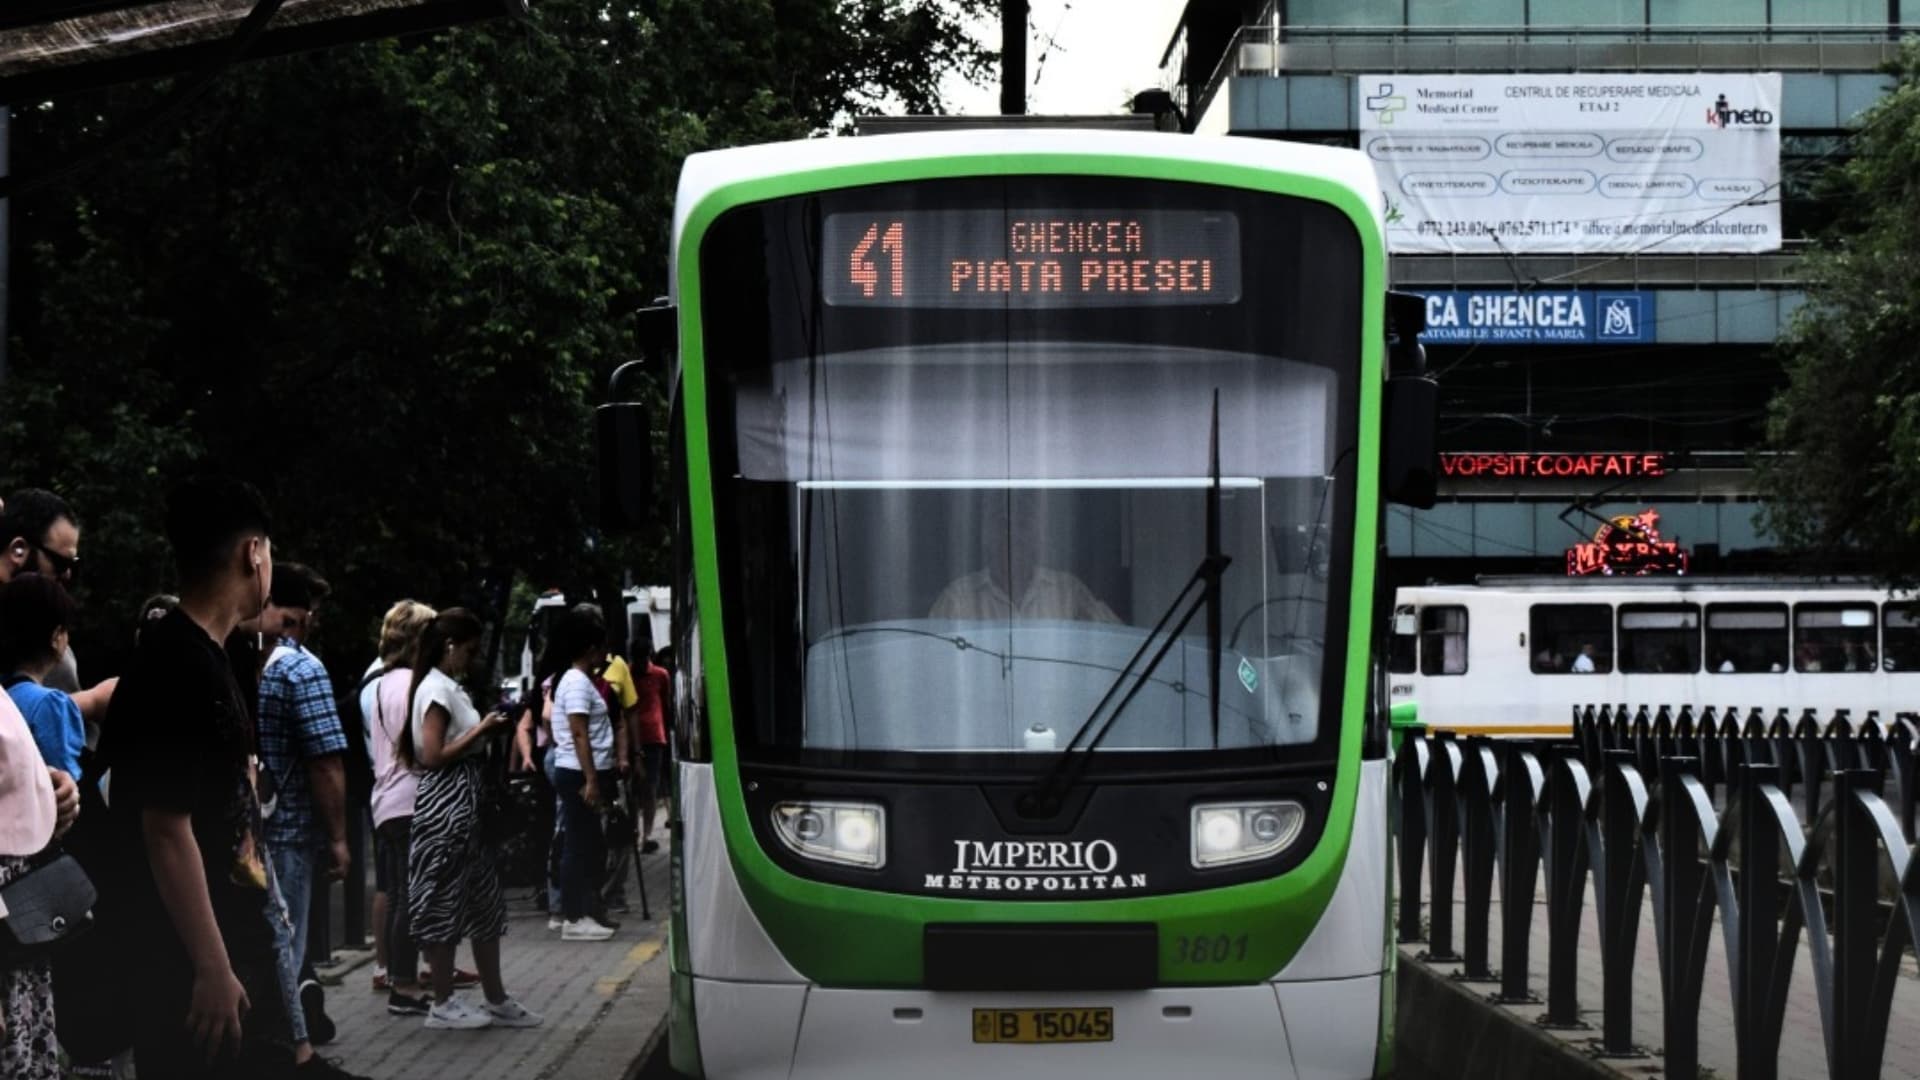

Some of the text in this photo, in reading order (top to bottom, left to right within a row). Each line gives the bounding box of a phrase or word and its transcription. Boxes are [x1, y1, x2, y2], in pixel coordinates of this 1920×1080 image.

[1417, 88, 1474, 100] Memorial
[1505, 85, 1701, 98] CENTRUL DE RECUPERARE MEDICALA
[1417, 103, 1499, 115] Medical Center
[1579, 102, 1620, 113] ETAJ 2
[1010, 220, 1143, 253] GHENCEA
[848, 222, 905, 298] 41
[950, 259, 1212, 293] PIATA PRESEI
[1467, 294, 1586, 327] GHENCEA
[1544, 328, 1585, 339] MARIA
[952, 839, 1118, 875] IMPERIO
[923, 872, 1148, 892] METROPOLITAN
[1171, 933, 1250, 964] 3801
[999, 1011, 1111, 1039] B 15045
